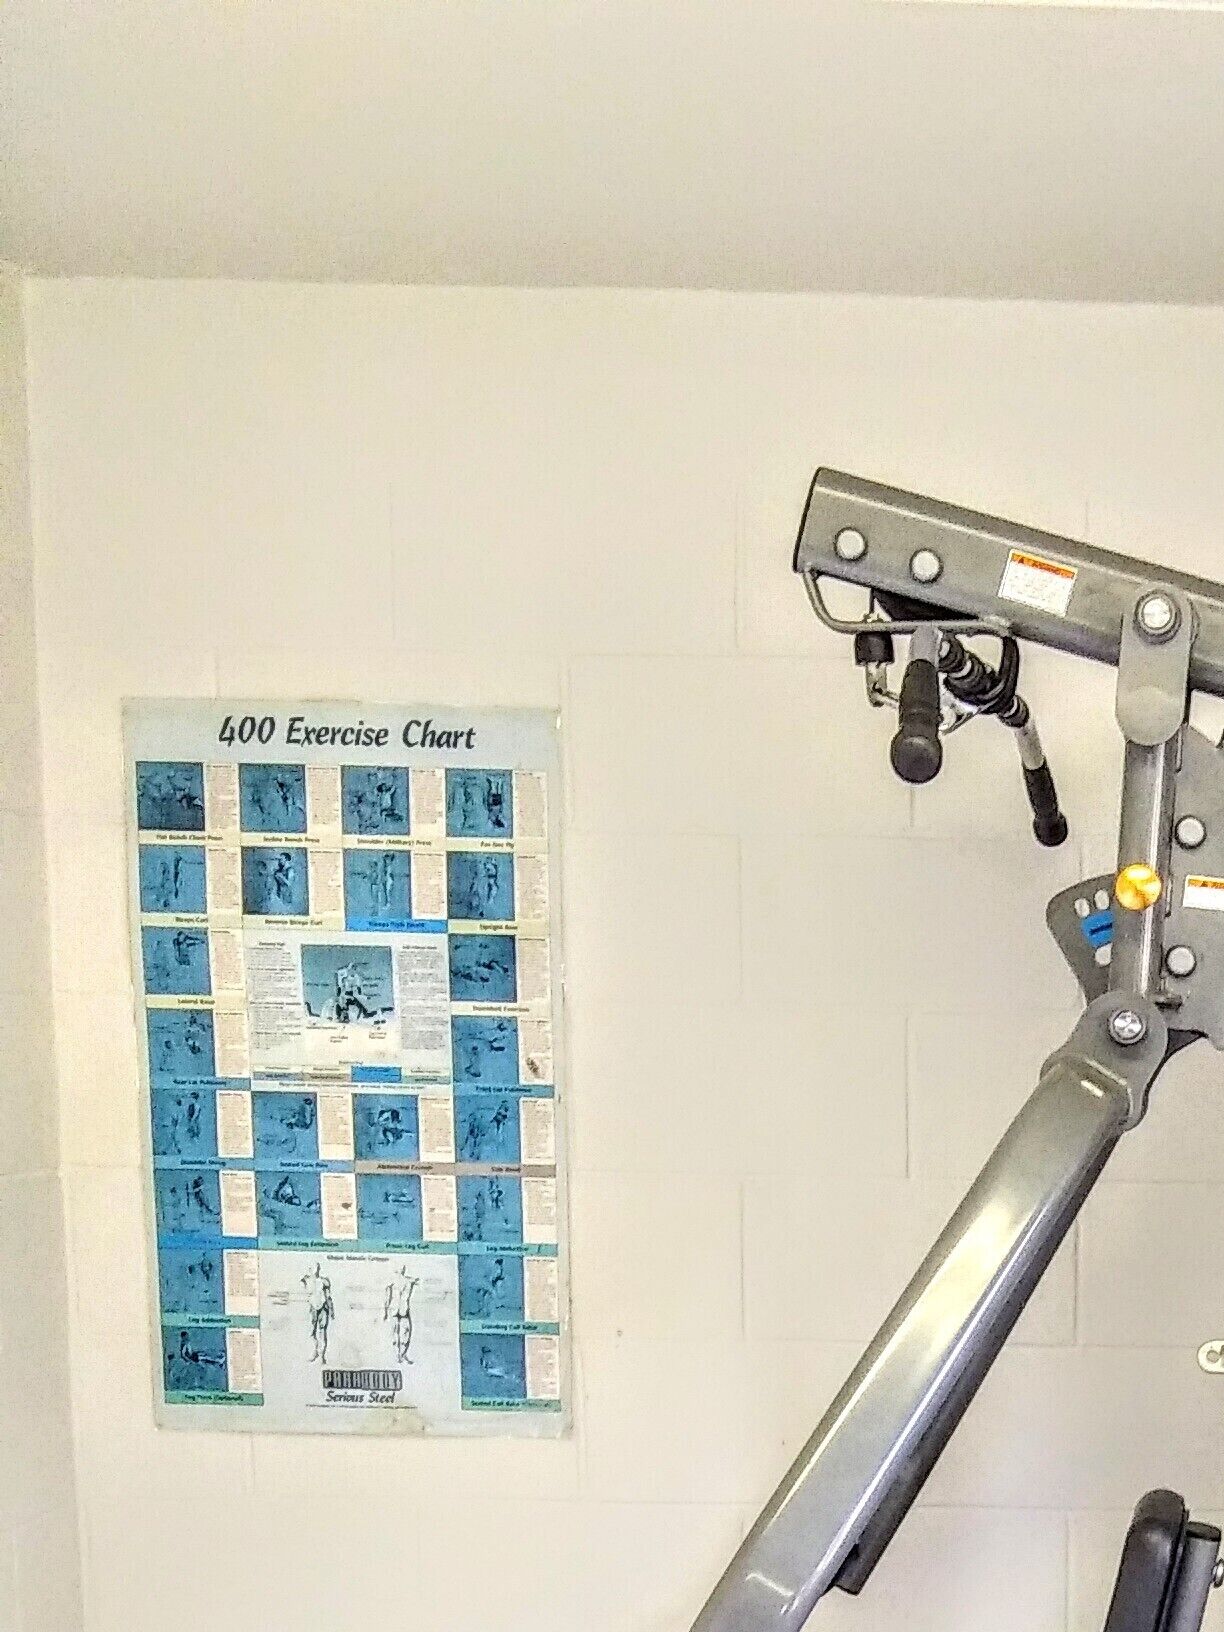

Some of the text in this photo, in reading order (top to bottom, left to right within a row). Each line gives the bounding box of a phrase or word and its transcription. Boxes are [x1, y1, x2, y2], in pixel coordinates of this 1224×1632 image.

[218, 715, 477, 750] 400 Exercise Chart
[325, 1391, 396, 1404] Serious Steel
